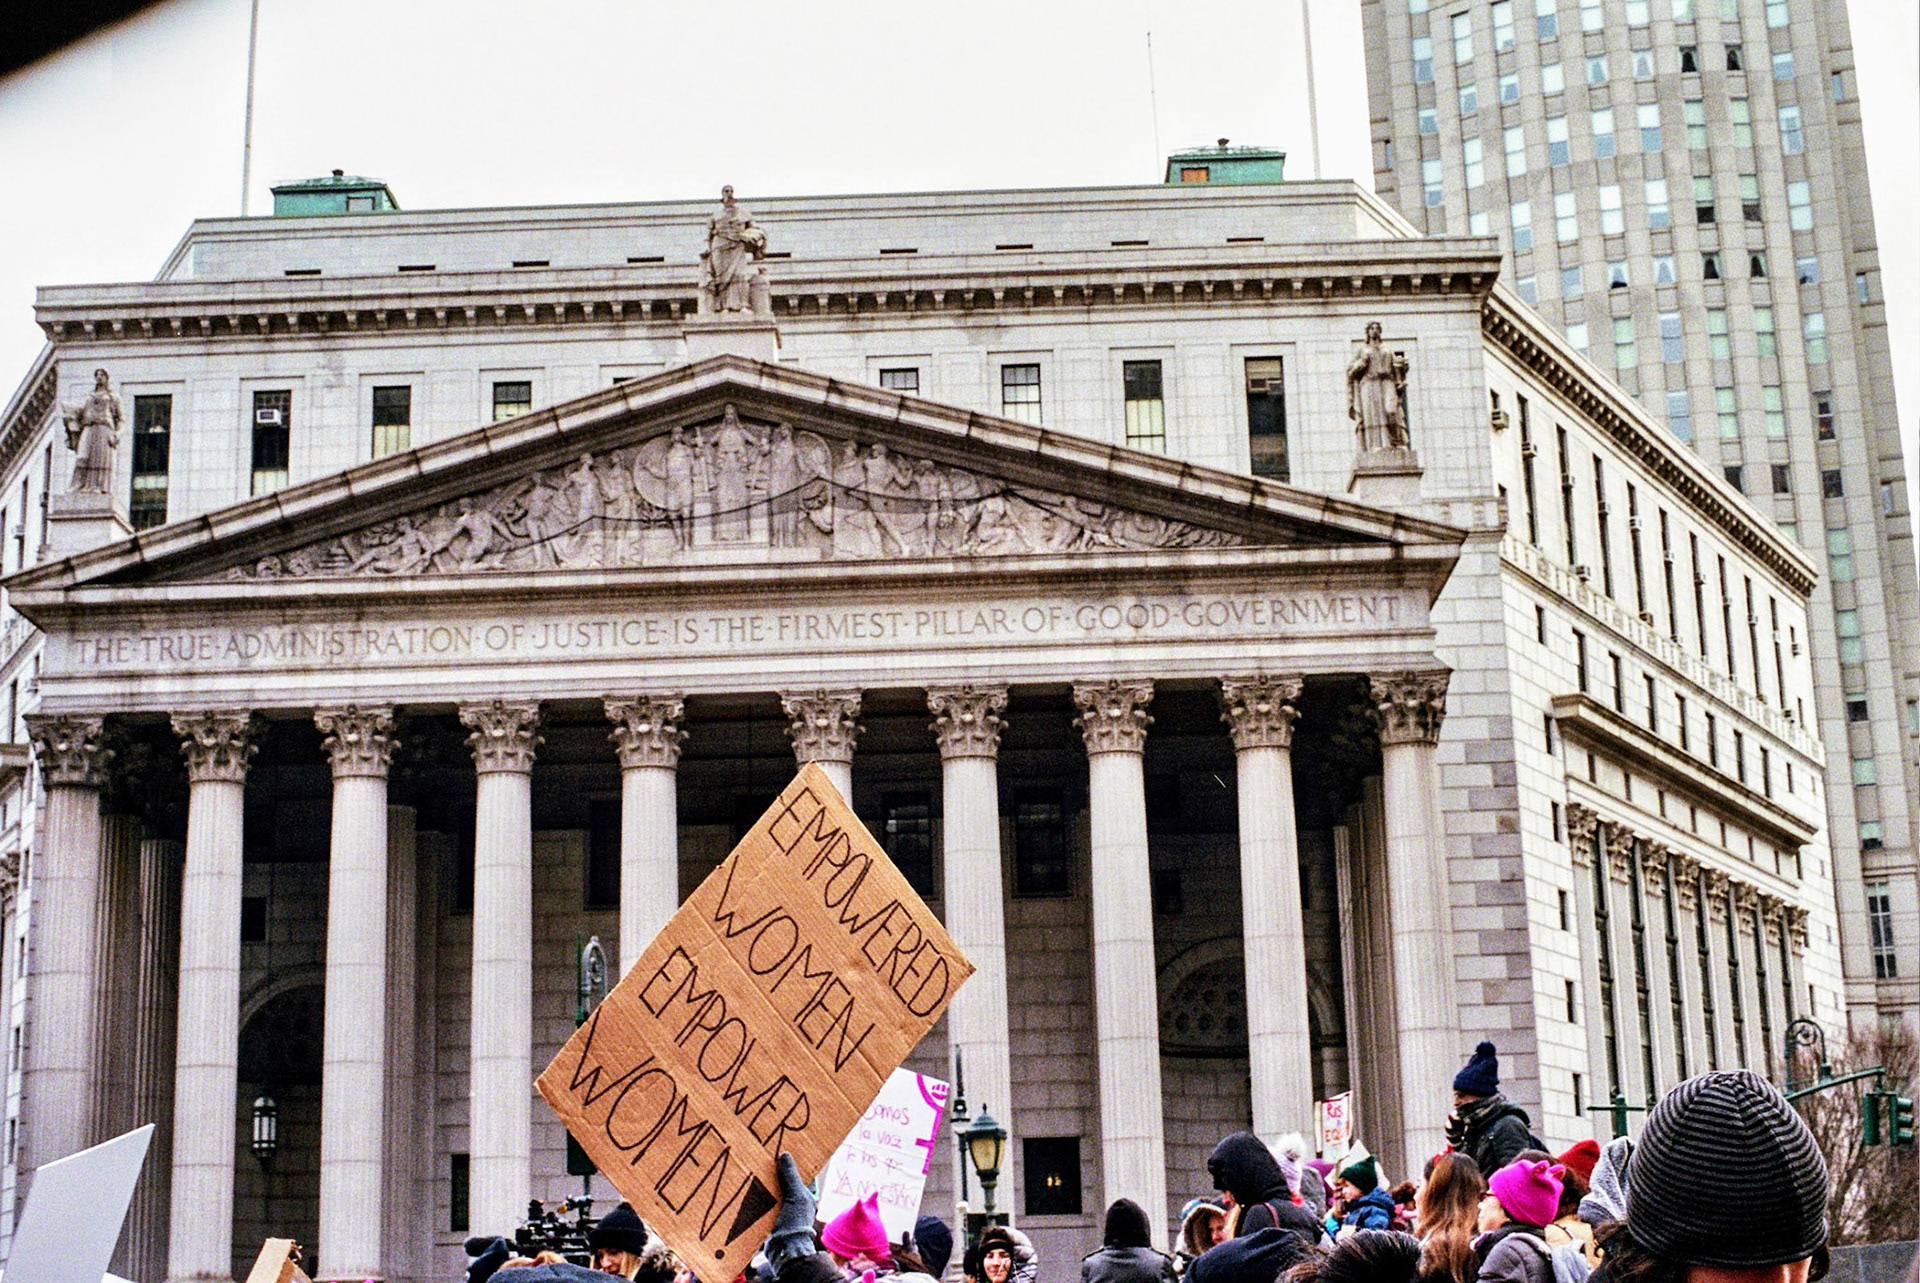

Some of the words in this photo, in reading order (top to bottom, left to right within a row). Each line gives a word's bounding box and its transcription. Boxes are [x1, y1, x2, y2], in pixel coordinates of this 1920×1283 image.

[76, 638, 132, 665] THE
[140, 634, 213, 662] TRUE
[220, 627, 474, 659] ADMINISTRATION
[479, 624, 524, 652] OF
[533, 621, 660, 650] JUSTICE
[670, 619, 698, 644] IS
[708, 615, 765, 644] THE
[777, 614, 901, 641] FIRMEST
[914, 610, 1009, 636] PILLAR
[1022, 607, 1061, 633] OF
[1075, 604, 1168, 632] GOOD
[1182, 596, 1399, 628] GOVERNMENT
[715, 855, 876, 1073] WOMEN
[768, 787, 950, 1018] EMPOWERED
[639, 946, 810, 1161] EMPOWER
